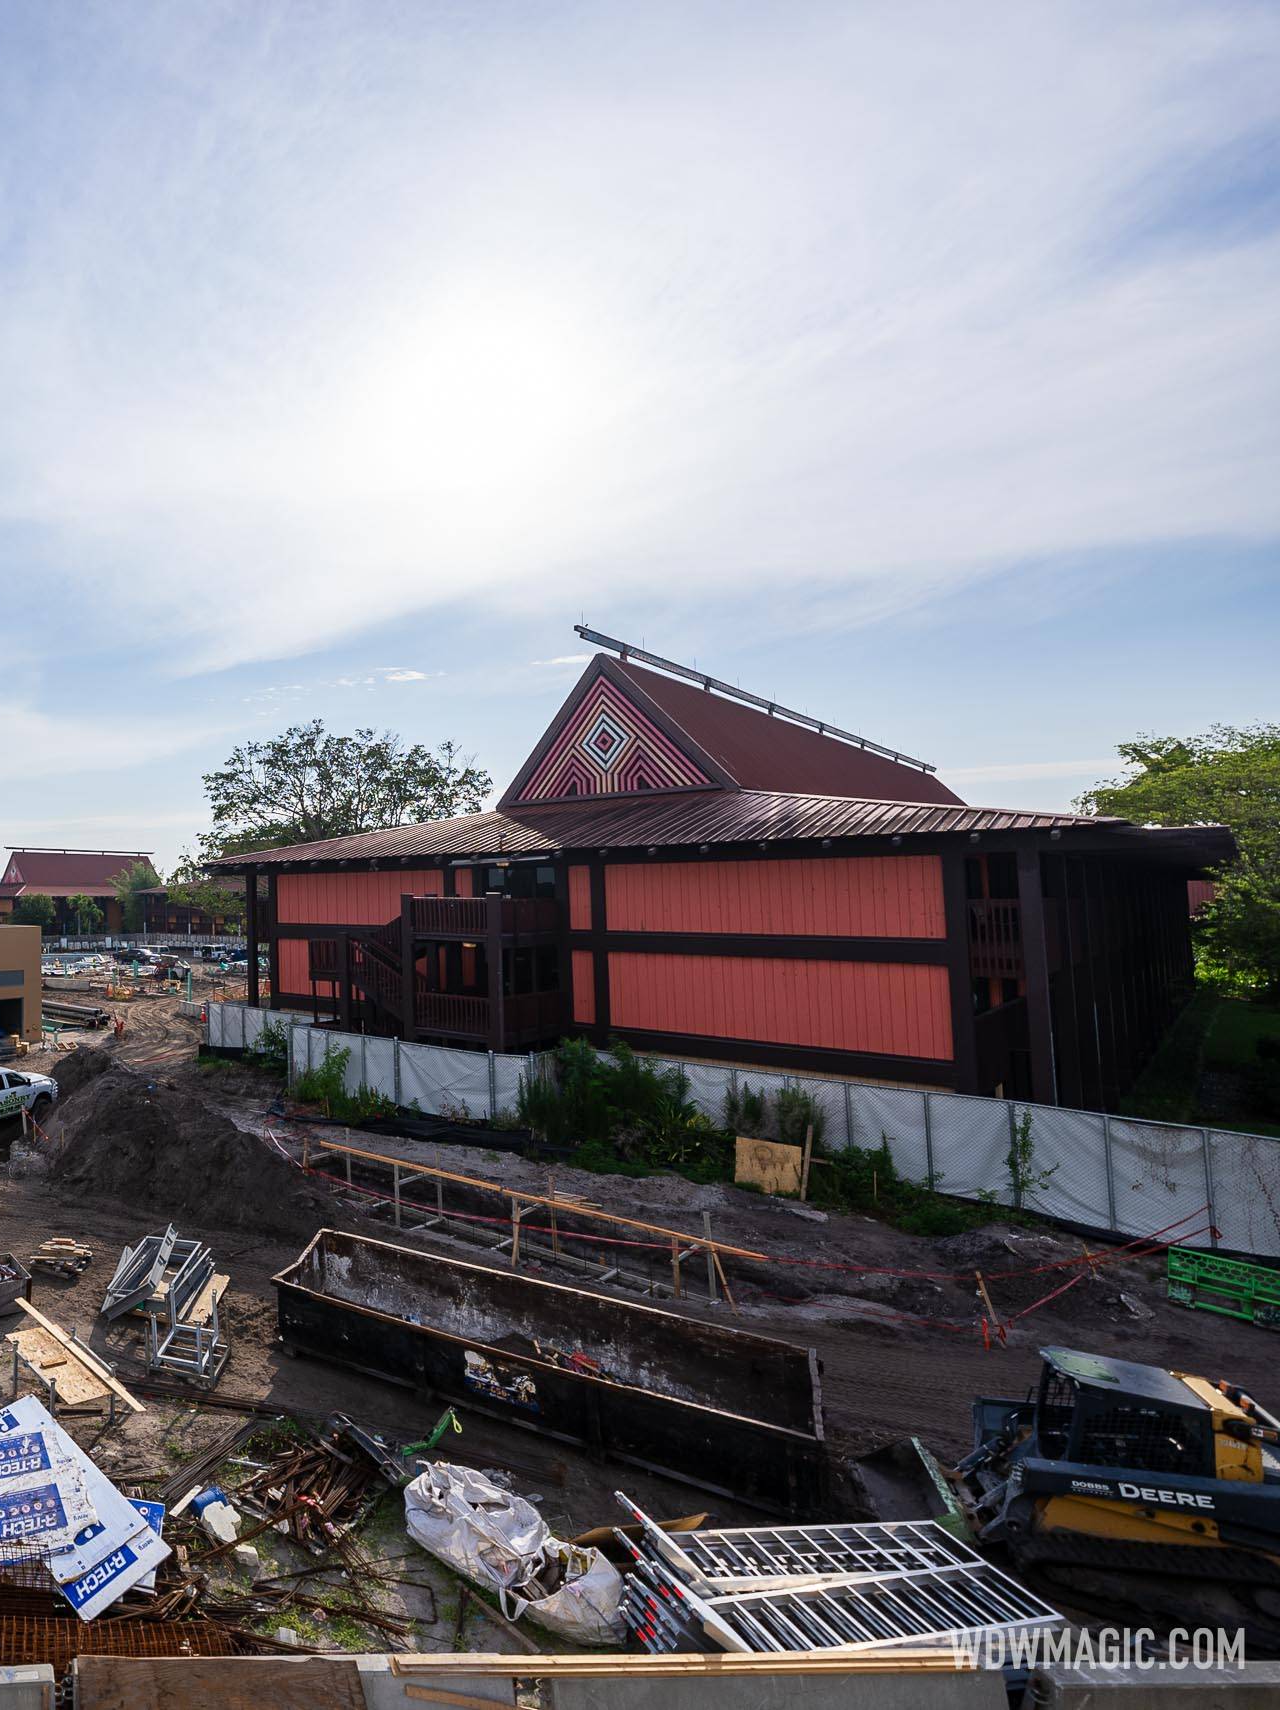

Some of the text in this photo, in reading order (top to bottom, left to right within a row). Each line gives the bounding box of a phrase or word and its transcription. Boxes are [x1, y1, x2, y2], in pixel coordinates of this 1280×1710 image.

[1071, 1480, 1110, 1491] DOBBS
[1118, 1482, 1216, 1510] DEERE
[1, 1512, 57, 1538] R-TECH
[75, 1550, 127, 1601] R-TECH
